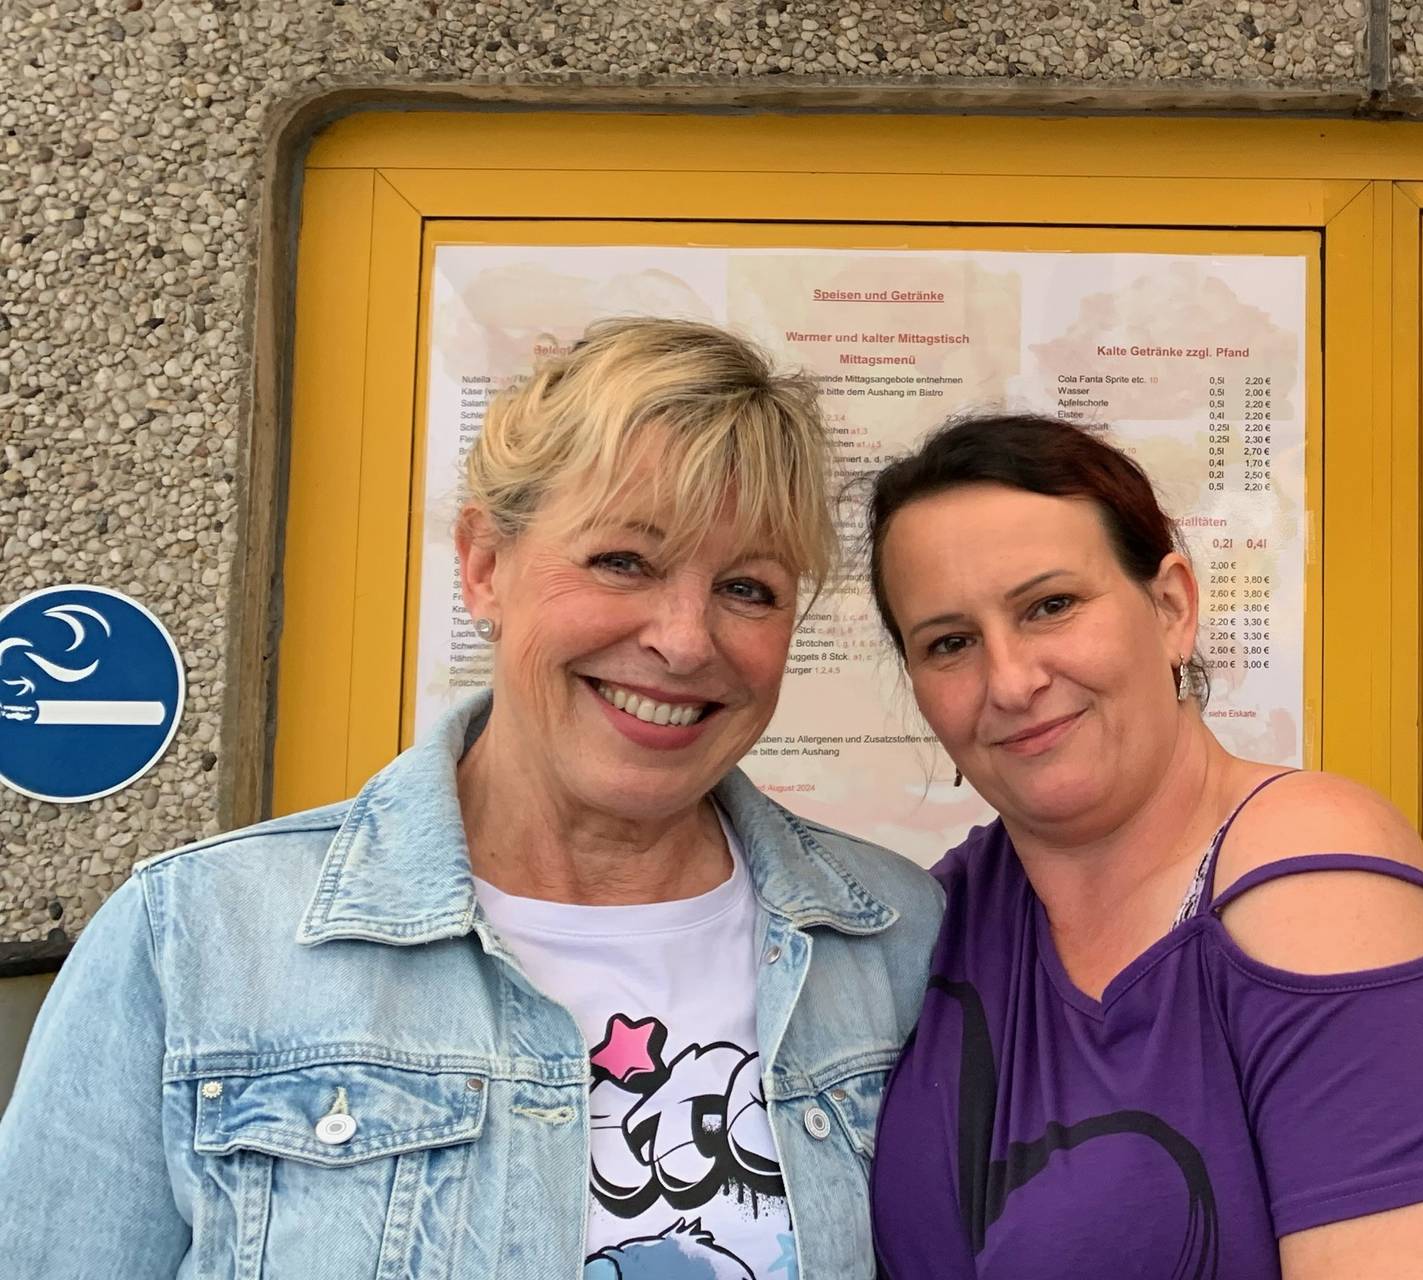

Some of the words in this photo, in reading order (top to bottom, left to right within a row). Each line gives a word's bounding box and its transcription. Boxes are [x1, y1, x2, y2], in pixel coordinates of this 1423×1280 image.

[813, 289, 862, 302] Speisen
[864, 290, 887, 300] und
[890, 290, 945, 302] Getränke
[785, 331, 832, 343] Warmer
[835, 333, 858, 343] und
[861, 333, 895, 343] kalter
[897, 333, 970, 346] Mittagstisch
[1097, 345, 1127, 357] Kalte
[1130, 346, 1184, 358] Getränke
[1186, 347, 1213, 359] zzgl.
[1215, 346, 1250, 358] Pfand
[839, 354, 917, 367] Mittagsmenü
[461, 375, 492, 384] Nutella
[845, 375, 914, 386] Mittagsangebote
[915, 376, 964, 384] entnehmen
[1058, 374, 1078, 384] Cola
[1079, 375, 1104, 384] Fanta
[1105, 375, 1130, 385] Sprite
[1131, 376, 1147, 384] etc.
[1245, 377, 1264, 385] 2,20
[460, 387, 484, 396] Käse
[826, 388, 845, 396] bitte
[847, 388, 866, 396] dem
[867, 388, 905, 398] Aushang
[906, 389, 917, 397] im
[919, 389, 944, 397] Bistro
[1057, 386, 1090, 395] Wasser
[1245, 388, 1263, 397] 2,00
[1265, 388, 1271, 396] €
[1057, 398, 1109, 408] Apfelschorle
[1245, 400, 1263, 408] 2,20
[1245, 412, 1263, 420] 2,20
[1245, 424, 1263, 432] 2,20
[1245, 435, 1263, 444] 2,30
[1265, 435, 1271, 443] €
[1244, 447, 1262, 456] 2,70
[1264, 447, 1270, 455] €
[1245, 459, 1263, 467] 1,70
[1245, 471, 1263, 479] 2,50
[1245, 482, 1263, 491] 2,20
[1265, 482, 1271, 490] €
[795, 638, 835, 648] Brötchen
[789, 653, 819, 663] uggets
[1230, 660, 1236, 668] €
[1264, 660, 1270, 668] €
[797, 735, 844, 746] Allergenen
[845, 735, 862, 744] und
[863, 734, 921, 744] Zusatzstoffen
[759, 748, 779, 756] bitte
[780, 748, 800, 756] dem
[801, 748, 840, 758] Aushang
[767, 783, 795, 793] August
[796, 783, 816, 792] 2024
